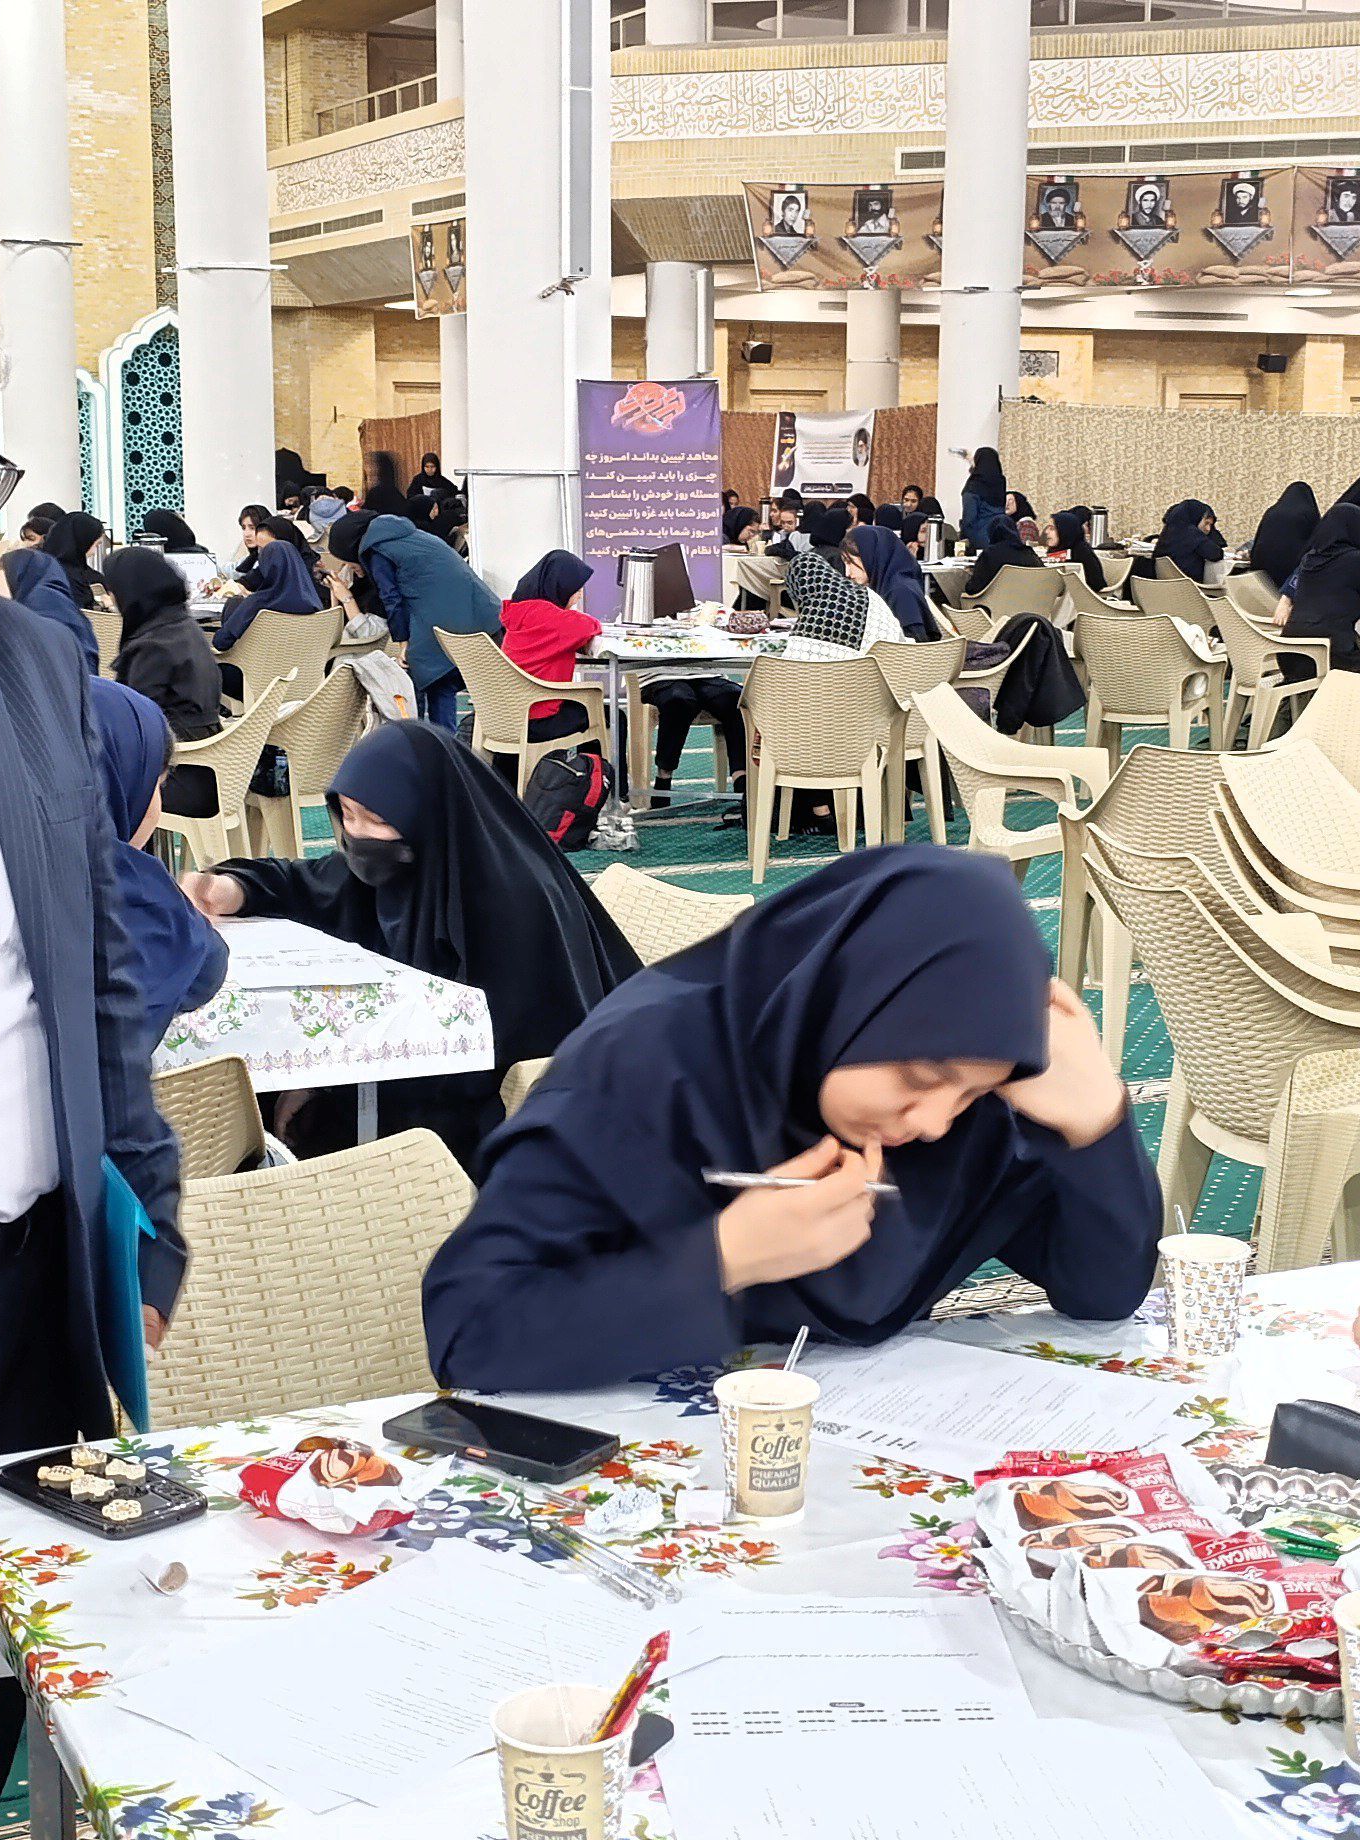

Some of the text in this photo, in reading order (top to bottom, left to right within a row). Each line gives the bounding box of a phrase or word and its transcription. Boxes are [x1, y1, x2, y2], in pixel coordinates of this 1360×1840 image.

[585, 453, 598, 464] چه
[599, 452, 630, 463] امروز
[632, 452, 660, 463] بداند
[661, 452, 685, 464] تبیین
[617, 472, 656, 482] تبیین
[657, 471, 676, 482] باید
[677, 471, 684, 481] را
[686, 472, 718, 483] چیزی
[633, 489, 640, 500] را
[641, 489, 673, 501] خودش
[674, 490, 689, 500] روز
[608, 509, 632, 520] تبیین
[633, 508, 640, 519] را
[658, 508, 674, 519] باید
[676, 508, 696, 517] شما
[697, 508, 720, 519] امروز
[646, 527, 668, 538] باید
[669, 527, 690, 536] شما
[691, 527, 719, 538] امروز
[690, 545, 712, 557] نظام
[713, 546, 720, 556] با
[751, 1435, 803, 1459] Coffee
[752, 1467, 799, 1479] PREMIUM
[752, 1475, 799, 1488] QUALITY
[515, 1783, 586, 1819] Coffee
[552, 1815, 580, 1828] shop
